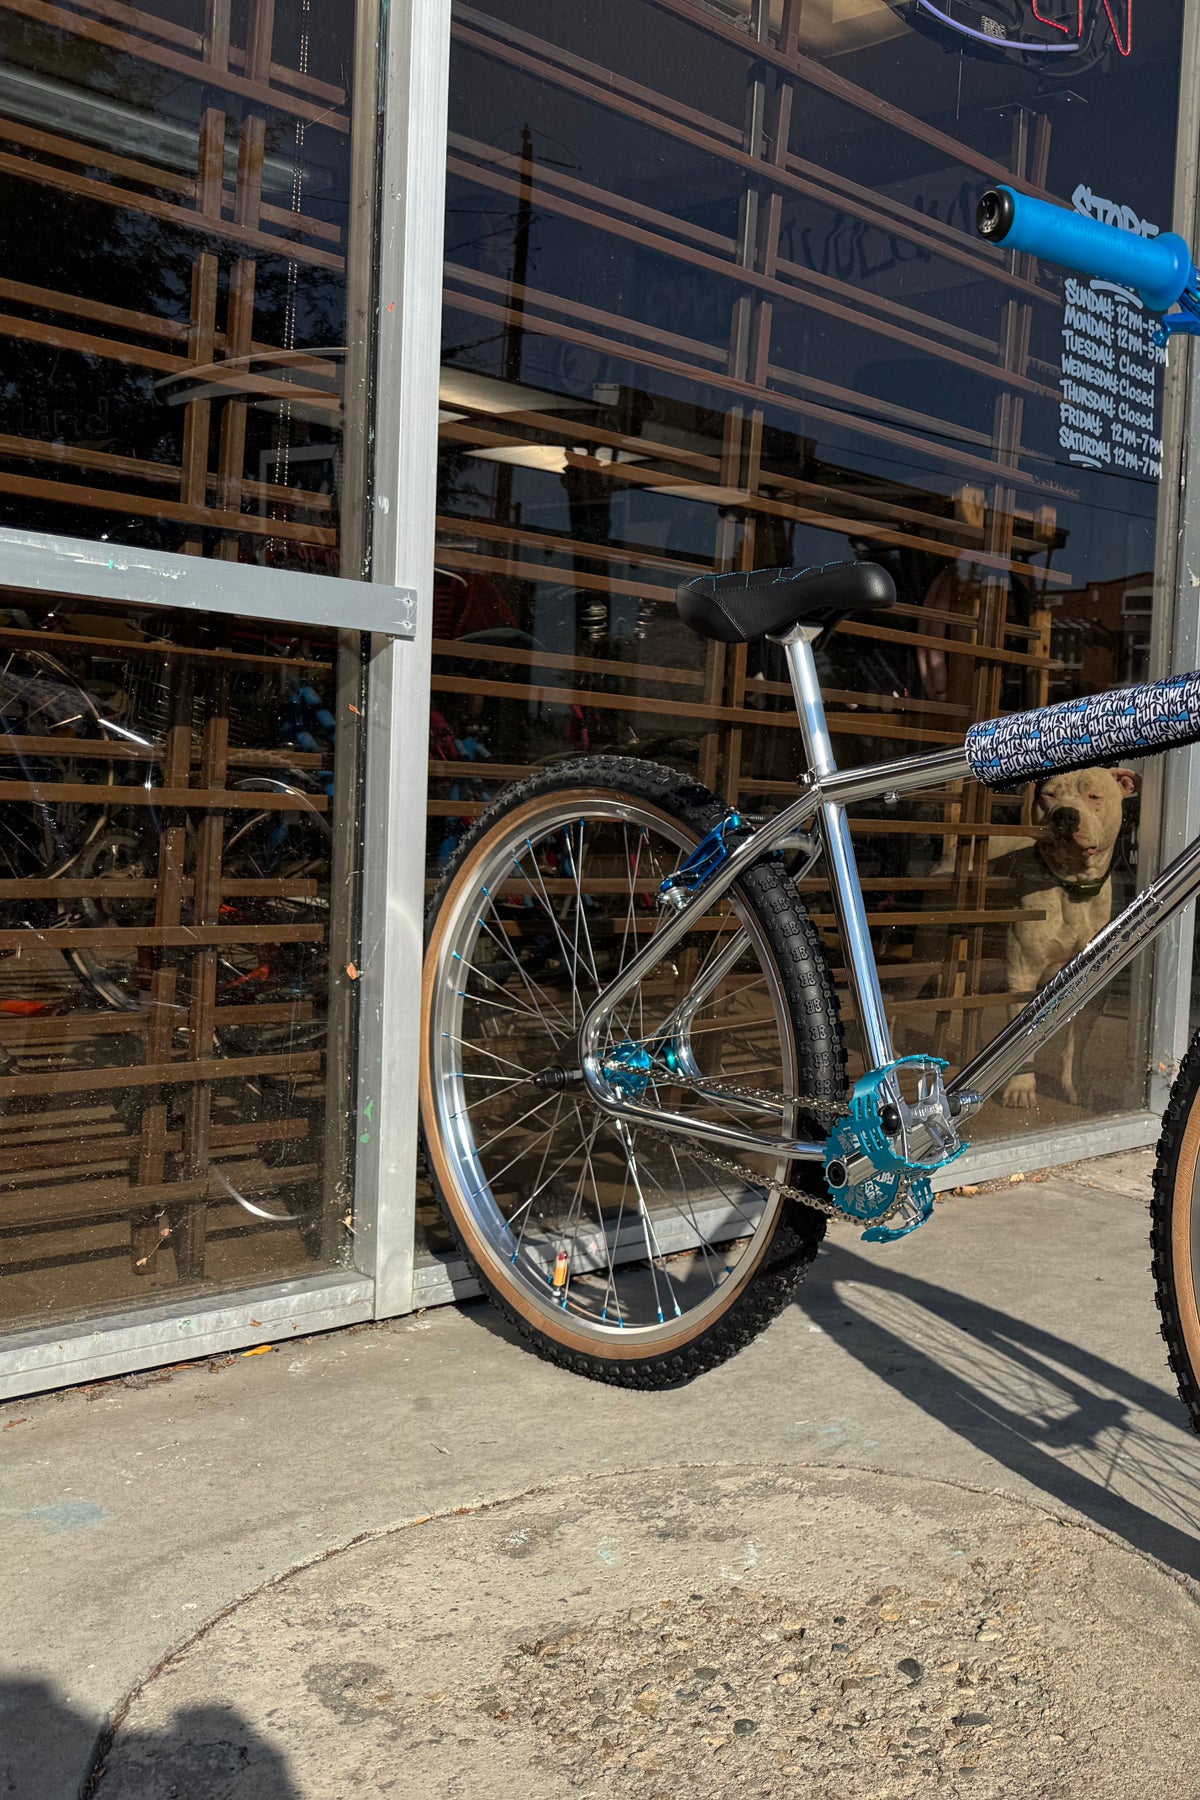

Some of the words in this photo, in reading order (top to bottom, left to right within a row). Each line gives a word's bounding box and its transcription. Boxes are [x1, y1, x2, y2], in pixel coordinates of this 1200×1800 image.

[1063, 304, 1115, 347] MONDAY:
[1064, 278, 1115, 322] SUNDAY:
[1061, 329, 1115, 370] TUESDAY:
[1119, 354, 1155, 386] Closed
[1061, 353, 1118, 395] WEDNESDAY:
[1119, 378, 1155, 409] Closed
[1059, 379, 1116, 419] THURSDAY:
[1118, 402, 1154, 432] Closed
[1059, 402, 1103, 437] FRIDAY:
[1059, 425, 1112, 464] SATURDAY
[993, 721, 1038, 748] FUCKING
[1040, 711, 1085, 732] AWESOME
[1085, 697, 1133, 725] FUCKING
[1134, 686, 1183, 707] AWESOME
[997, 739, 1040, 758] AWESOME
[1041, 726, 1087, 751] FUCKING
[1088, 714, 1136, 735] AWESOME
[1136, 700, 1186, 730] FUCKING
[1001, 750, 1046, 775] FUCKING
[1046, 743, 1095, 761] AWESOME
[1091, 728, 1140, 754] FUCKING
[1141, 720, 1192, 739] AWESOME
